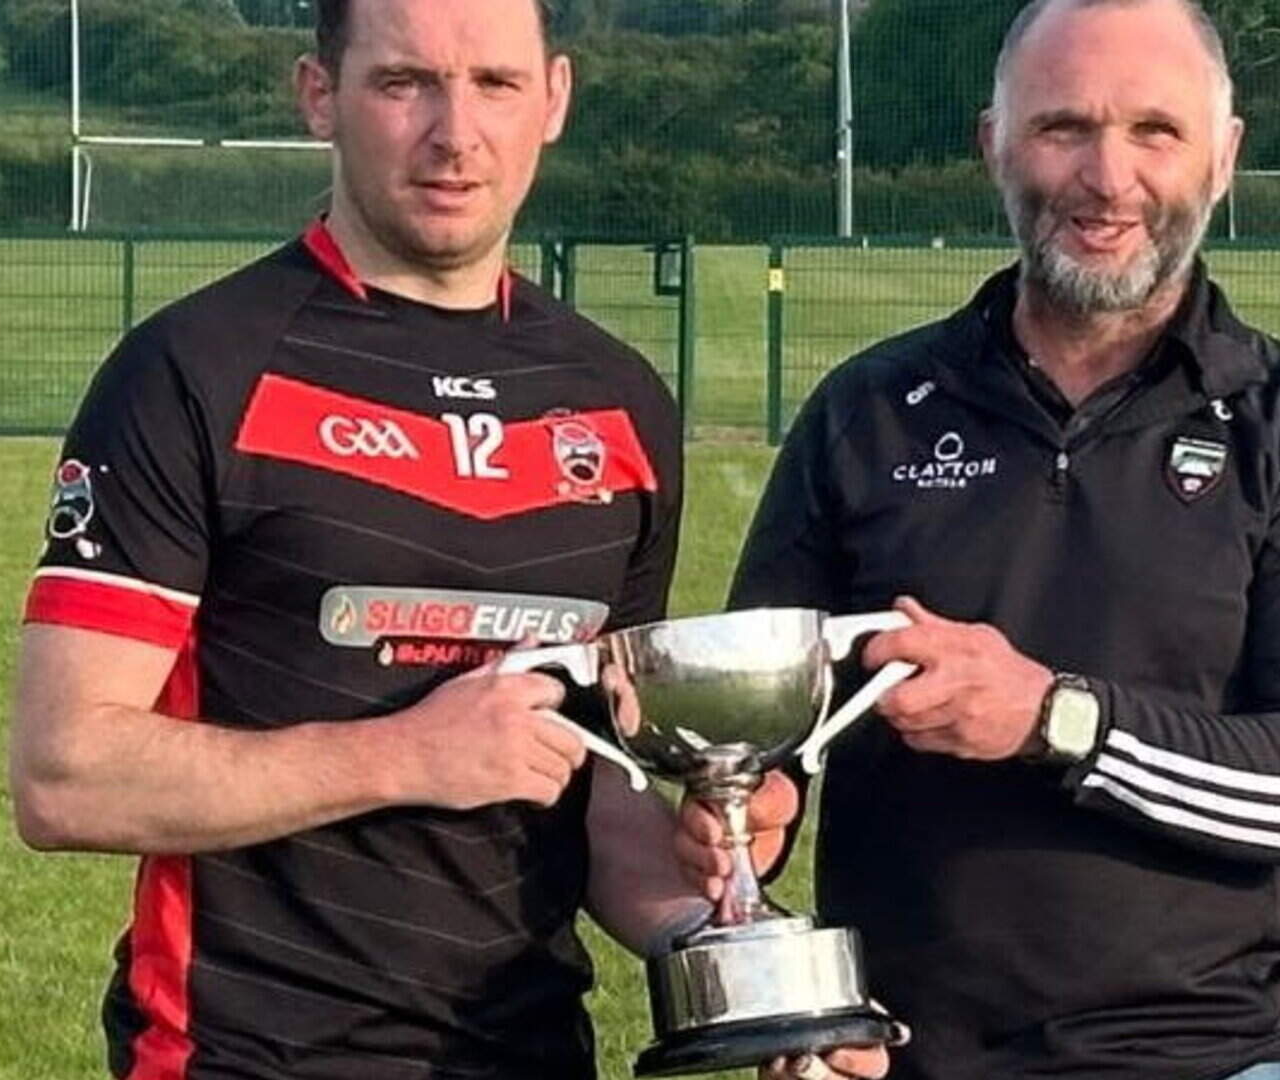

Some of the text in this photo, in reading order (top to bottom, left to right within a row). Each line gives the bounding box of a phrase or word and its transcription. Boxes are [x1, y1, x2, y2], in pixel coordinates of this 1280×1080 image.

[432, 376, 497, 399] KCS
[441, 412, 508, 479] 12
[893, 458, 997, 481] CLAYTON
